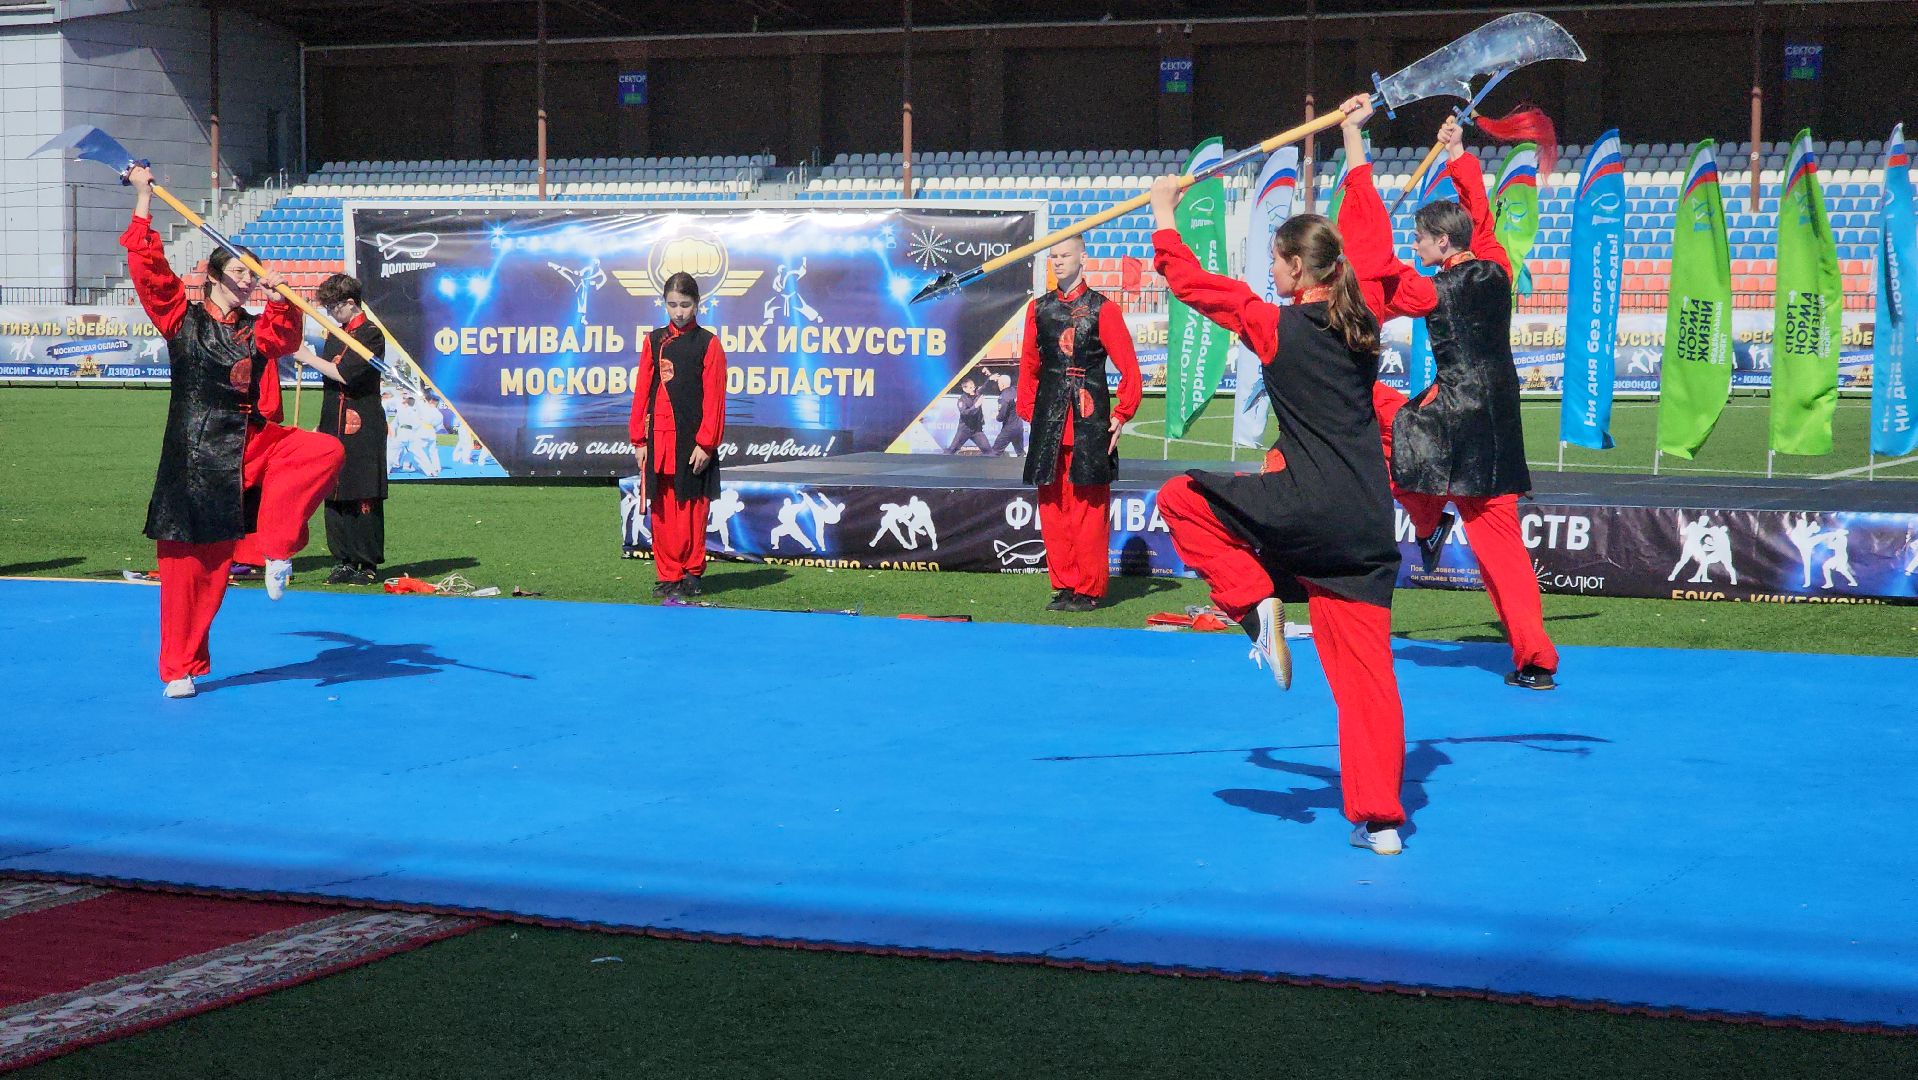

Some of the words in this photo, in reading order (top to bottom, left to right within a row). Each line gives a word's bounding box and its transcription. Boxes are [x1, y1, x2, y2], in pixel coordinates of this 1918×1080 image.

[1160, 61, 1192, 71] СЕКТОР
[1174, 71, 1181, 80] 2
[955, 241, 1012, 262] САЛЮТ
[66, 316, 129, 336] БОЕВЫХ
[1586, 319, 1601, 354] без
[1677, 306, 1689, 359] СПОРТ
[1686, 298, 1701, 361] НОРМА
[1697, 300, 1714, 363] ЖИЗНИ
[1785, 303, 1798, 354] СПОРТ
[1794, 292, 1813, 355] НОРМА
[433, 325, 625, 356] ФЕСТИВАЛЬ
[776, 325, 947, 356] ИСКУССТВ
[36, 367, 70, 376] КАРАТЕ
[107, 366, 141, 377] ДЗЮДО
[726, 366, 875, 397] ОБЛАСТИ
[1587, 358, 1599, 397] дня
[1583, 400, 1597, 427] Ни
[531, 434, 577, 460] Будь
[745, 435, 836, 463] первым!
[1554, 574, 1606, 594] САЛЮТ
